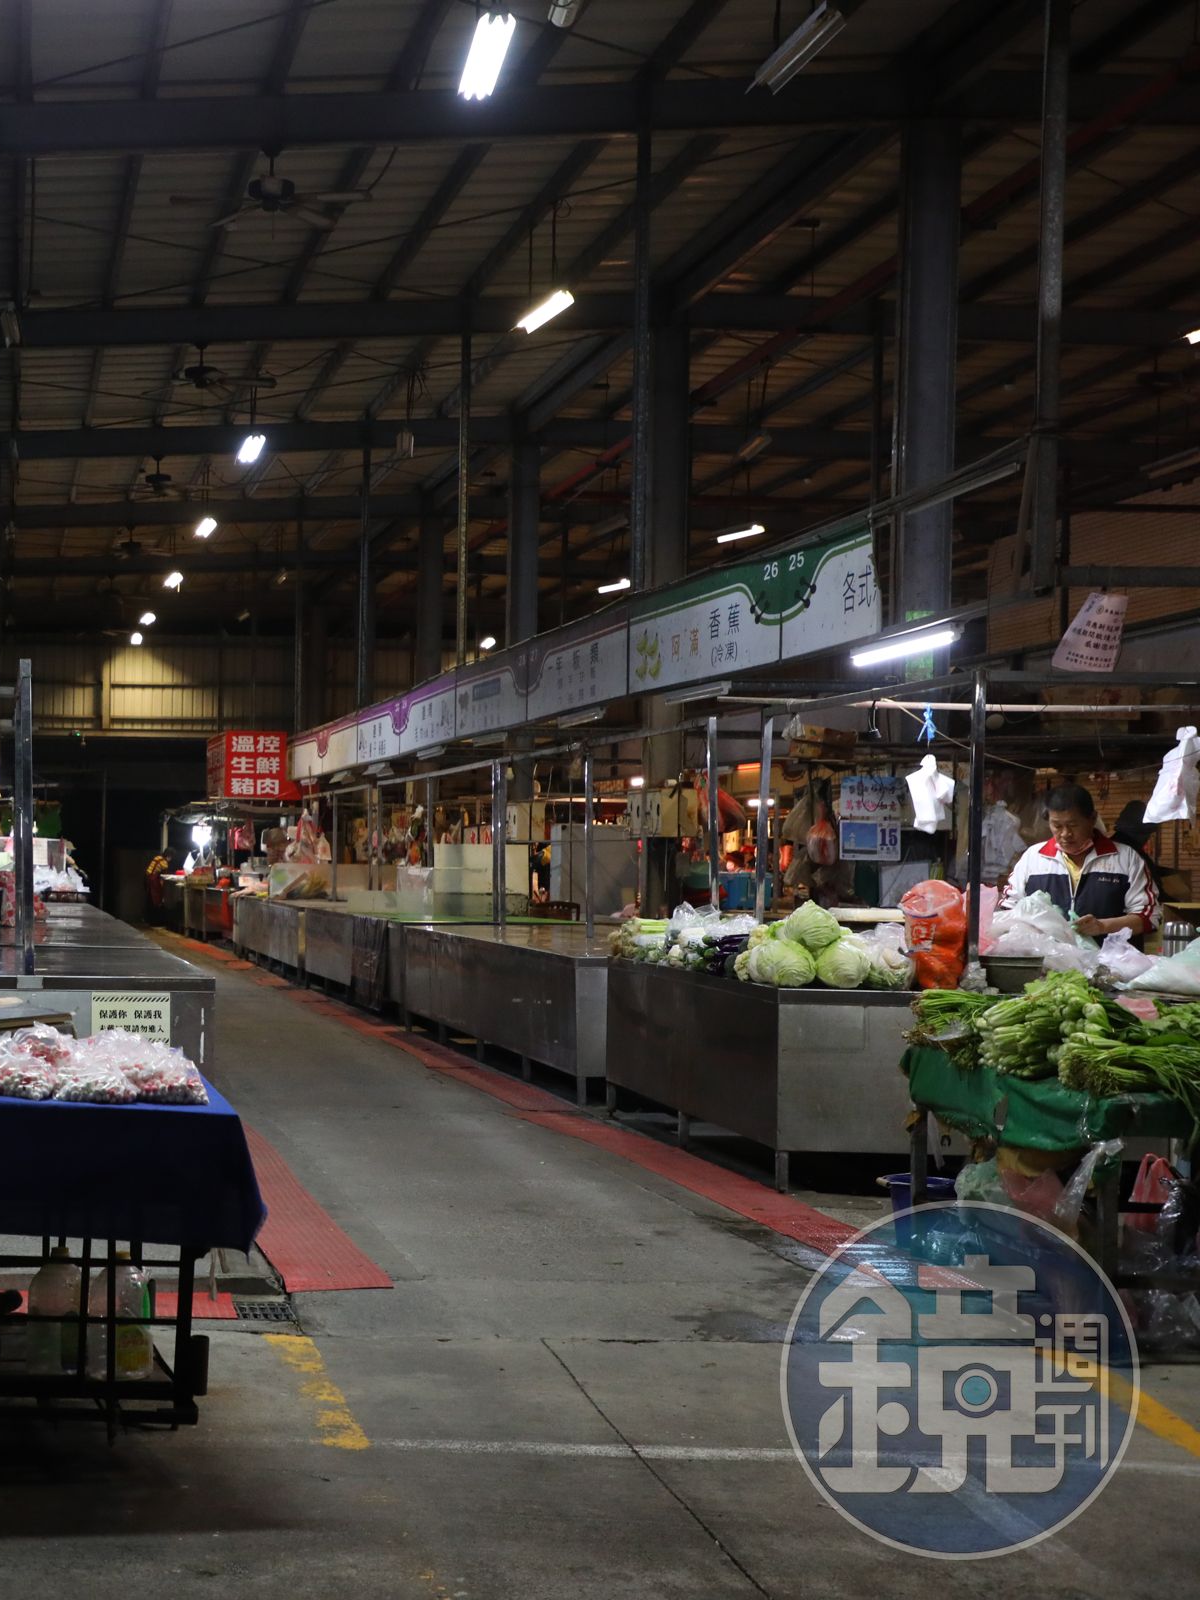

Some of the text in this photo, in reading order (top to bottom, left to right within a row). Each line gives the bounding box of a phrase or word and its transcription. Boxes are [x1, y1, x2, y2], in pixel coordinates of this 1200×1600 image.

[763, 551, 805, 581] 26 25
[709, 602, 740, 640] 香蕉
[231, 735, 280, 753] 溫控
[231, 756, 280, 774] 生鮮
[231, 777, 280, 796] 豬肉
[879, 828, 898, 846] 15
[99, 1009, 162, 1019] 保護你 保護我
